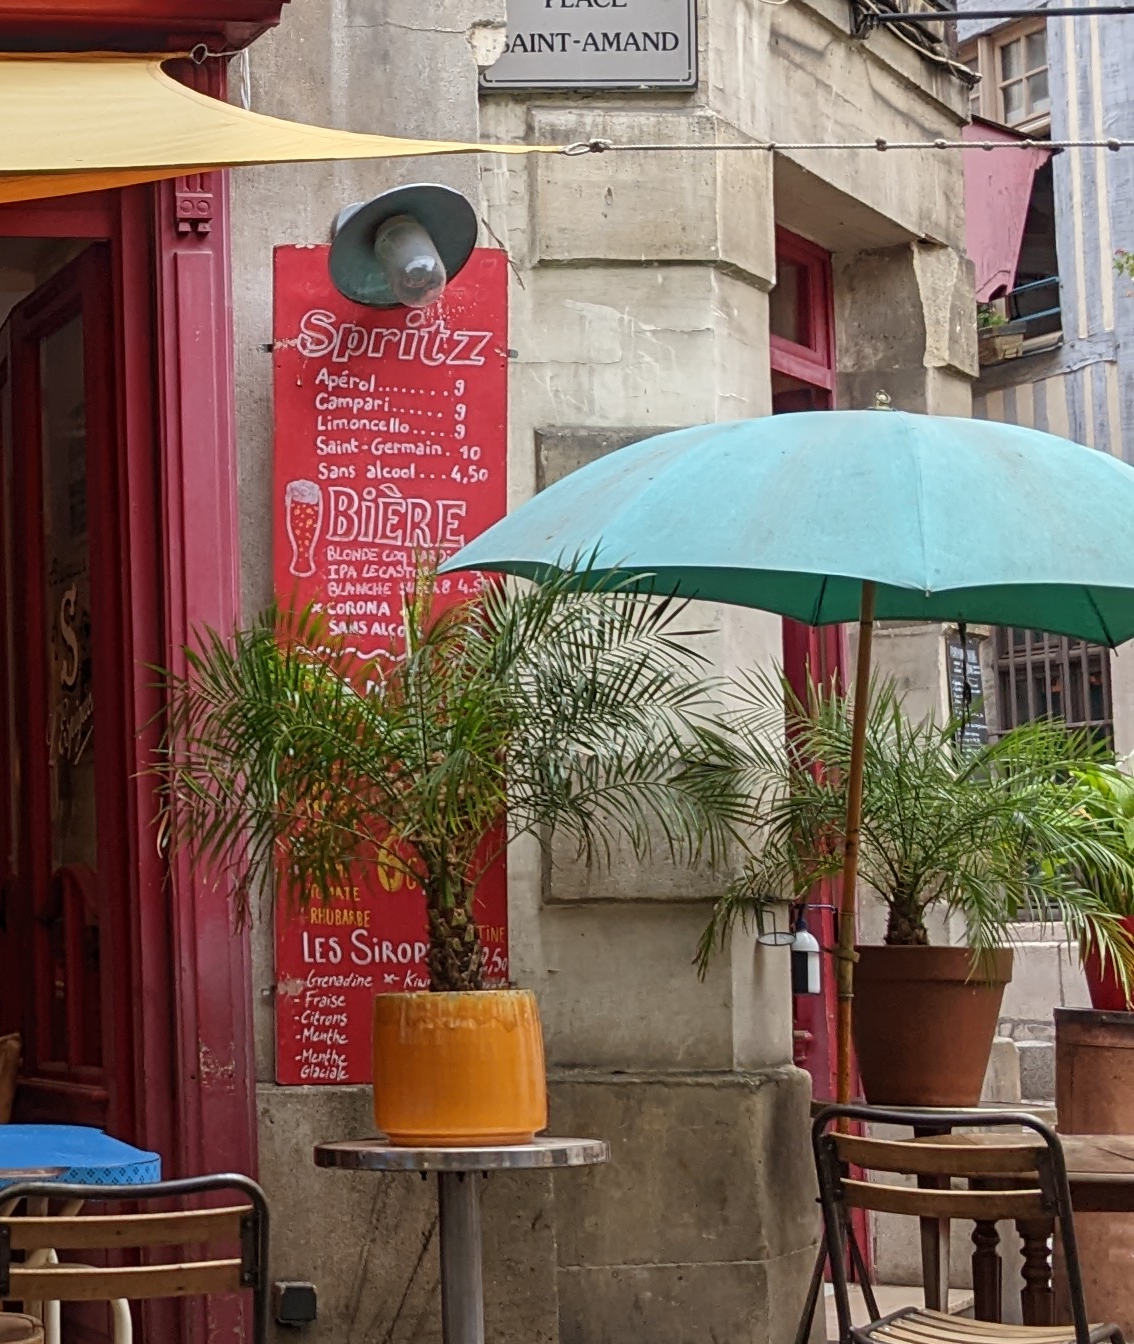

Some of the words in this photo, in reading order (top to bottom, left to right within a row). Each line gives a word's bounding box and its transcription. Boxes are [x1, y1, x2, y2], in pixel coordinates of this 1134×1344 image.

[298, 310, 494, 366] Spritz
[316, 367, 376, 392] Apérol
[316, 392, 390, 415] Campari
[317, 416, 410, 434] Limoncello
[459, 445, 481, 461] 10
[318, 462, 357, 481] Sans
[366, 460, 416, 480] alcool
[450, 464, 489, 484] 4,50
[327, 546, 379, 562] BLONDE
[327, 564, 358, 580] IPA
[327, 581, 392, 598] BLANCHE
[327, 600, 391, 618] CORONA
[328, 619, 368, 637] SANS
[302, 931, 343, 964] LES
[307, 969, 374, 988] Grenadine
[304, 989, 346, 1008] Fraise
[302, 1026, 349, 1045] Menthe
[302, 1047, 349, 1066] Menthe
[300, 1064, 350, 1082] Glaciale
